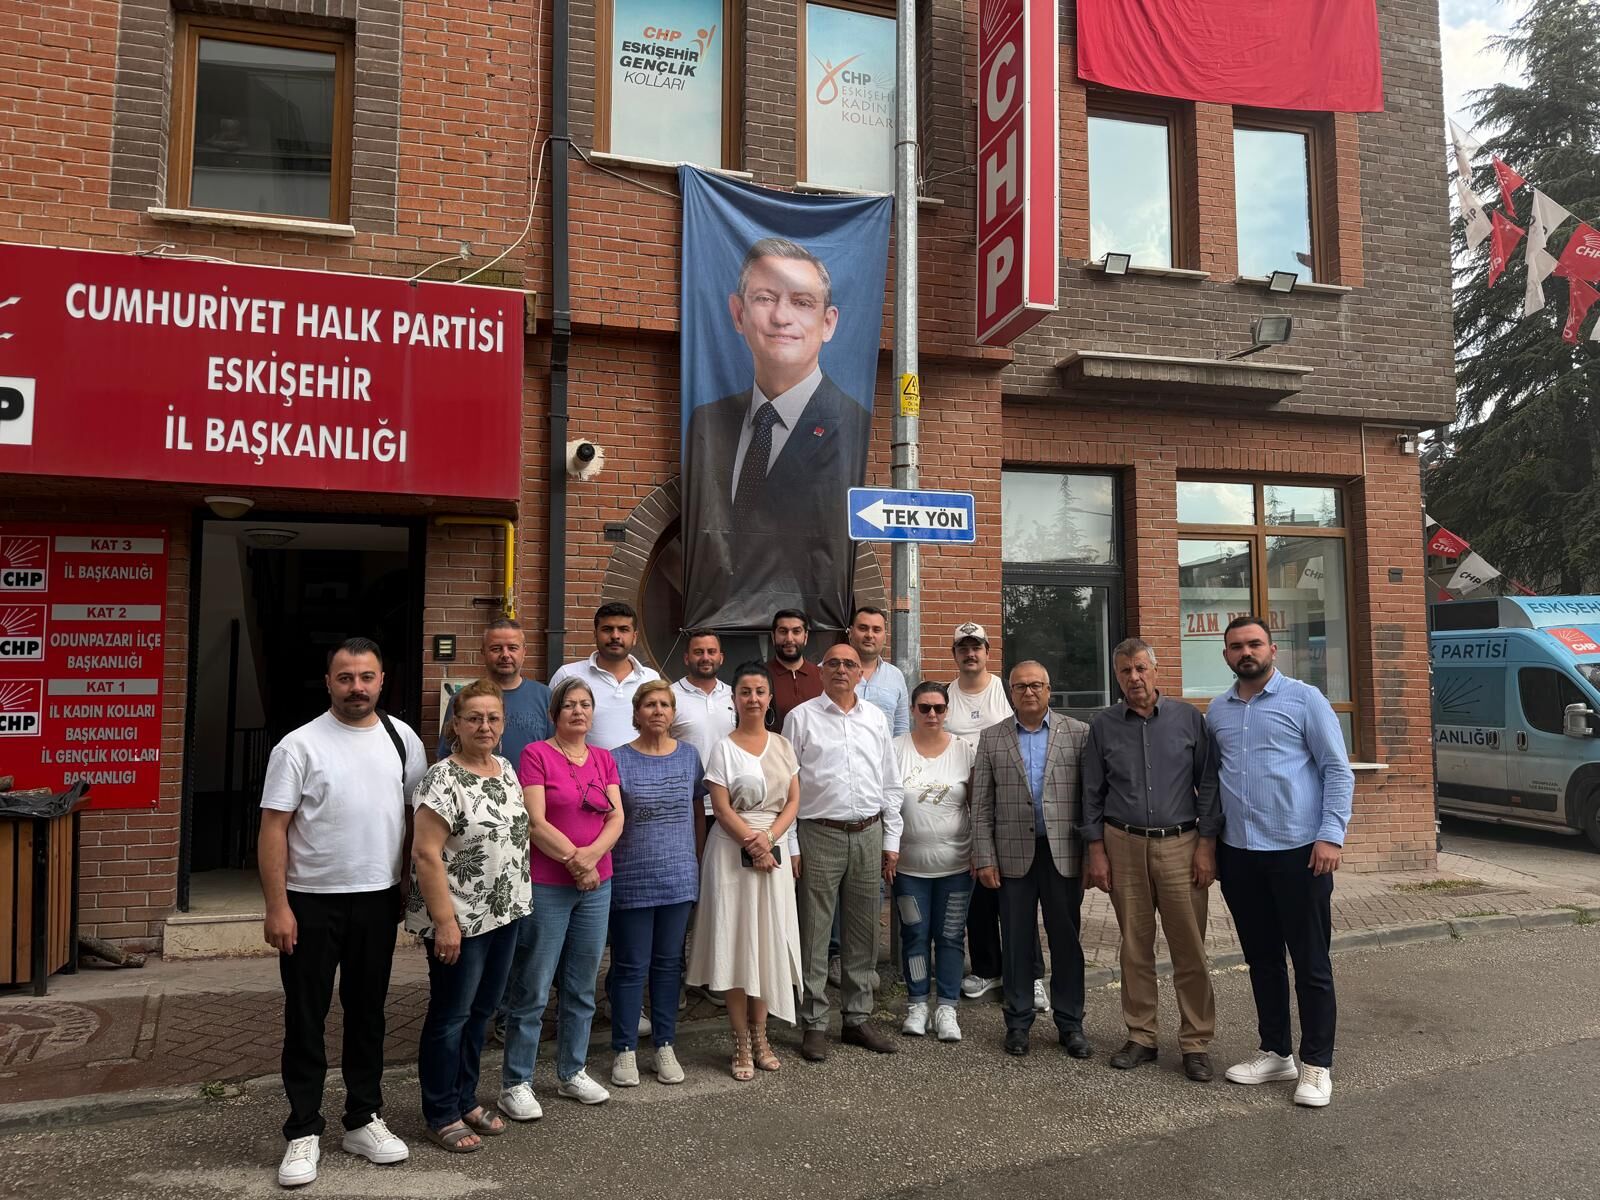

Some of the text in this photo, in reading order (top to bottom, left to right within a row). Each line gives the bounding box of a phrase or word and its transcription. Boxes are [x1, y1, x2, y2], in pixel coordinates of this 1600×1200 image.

[643, 26, 682, 41] CHP
[621, 40, 699, 62] ESKİŞEHİR
[620, 55, 697, 77] GENÇLİK
[624, 71, 686, 91] KOLLARI
[841, 70, 871, 86] CHP
[841, 86, 895, 104] ESKİŞEHİ
[841, 98, 887, 114] KADIN
[841, 111, 894, 129] KOLLAR
[985, 41, 1017, 320] CHP
[66, 283, 505, 354] CUMHURİYET HALK PARTİSİ
[207, 350, 372, 407] ESKİŞEHİR
[165, 404, 408, 465] İL BAŞKANLIĞI
[883, 508, 963, 528] TEK YÖN
[91, 539, 132, 551] KAT 3
[1432, 543, 1456, 553] CHP
[3, 572, 43, 587] CHP
[64, 562, 153, 582] İL BAŞKANLIĞI
[1459, 571, 1482, 585] CHP
[87, 608, 127, 619] KAT 2
[1187, 612, 1219, 633] ZAM
[0, 641, 39, 656] CHP
[50, 629, 161, 651] ODUNPAZARI İLÇE
[1441, 639, 1508, 659] PARTİSİ
[67, 651, 142, 672] BAŞKANLIĞI
[86, 681, 126, 693] KAT 1
[63, 704, 103, 718] KADIN
[107, 703, 155, 718] KOLLARI
[0, 715, 35, 731] CHP
[41, 745, 159, 766] İL GENÇLİK KOLLARI
